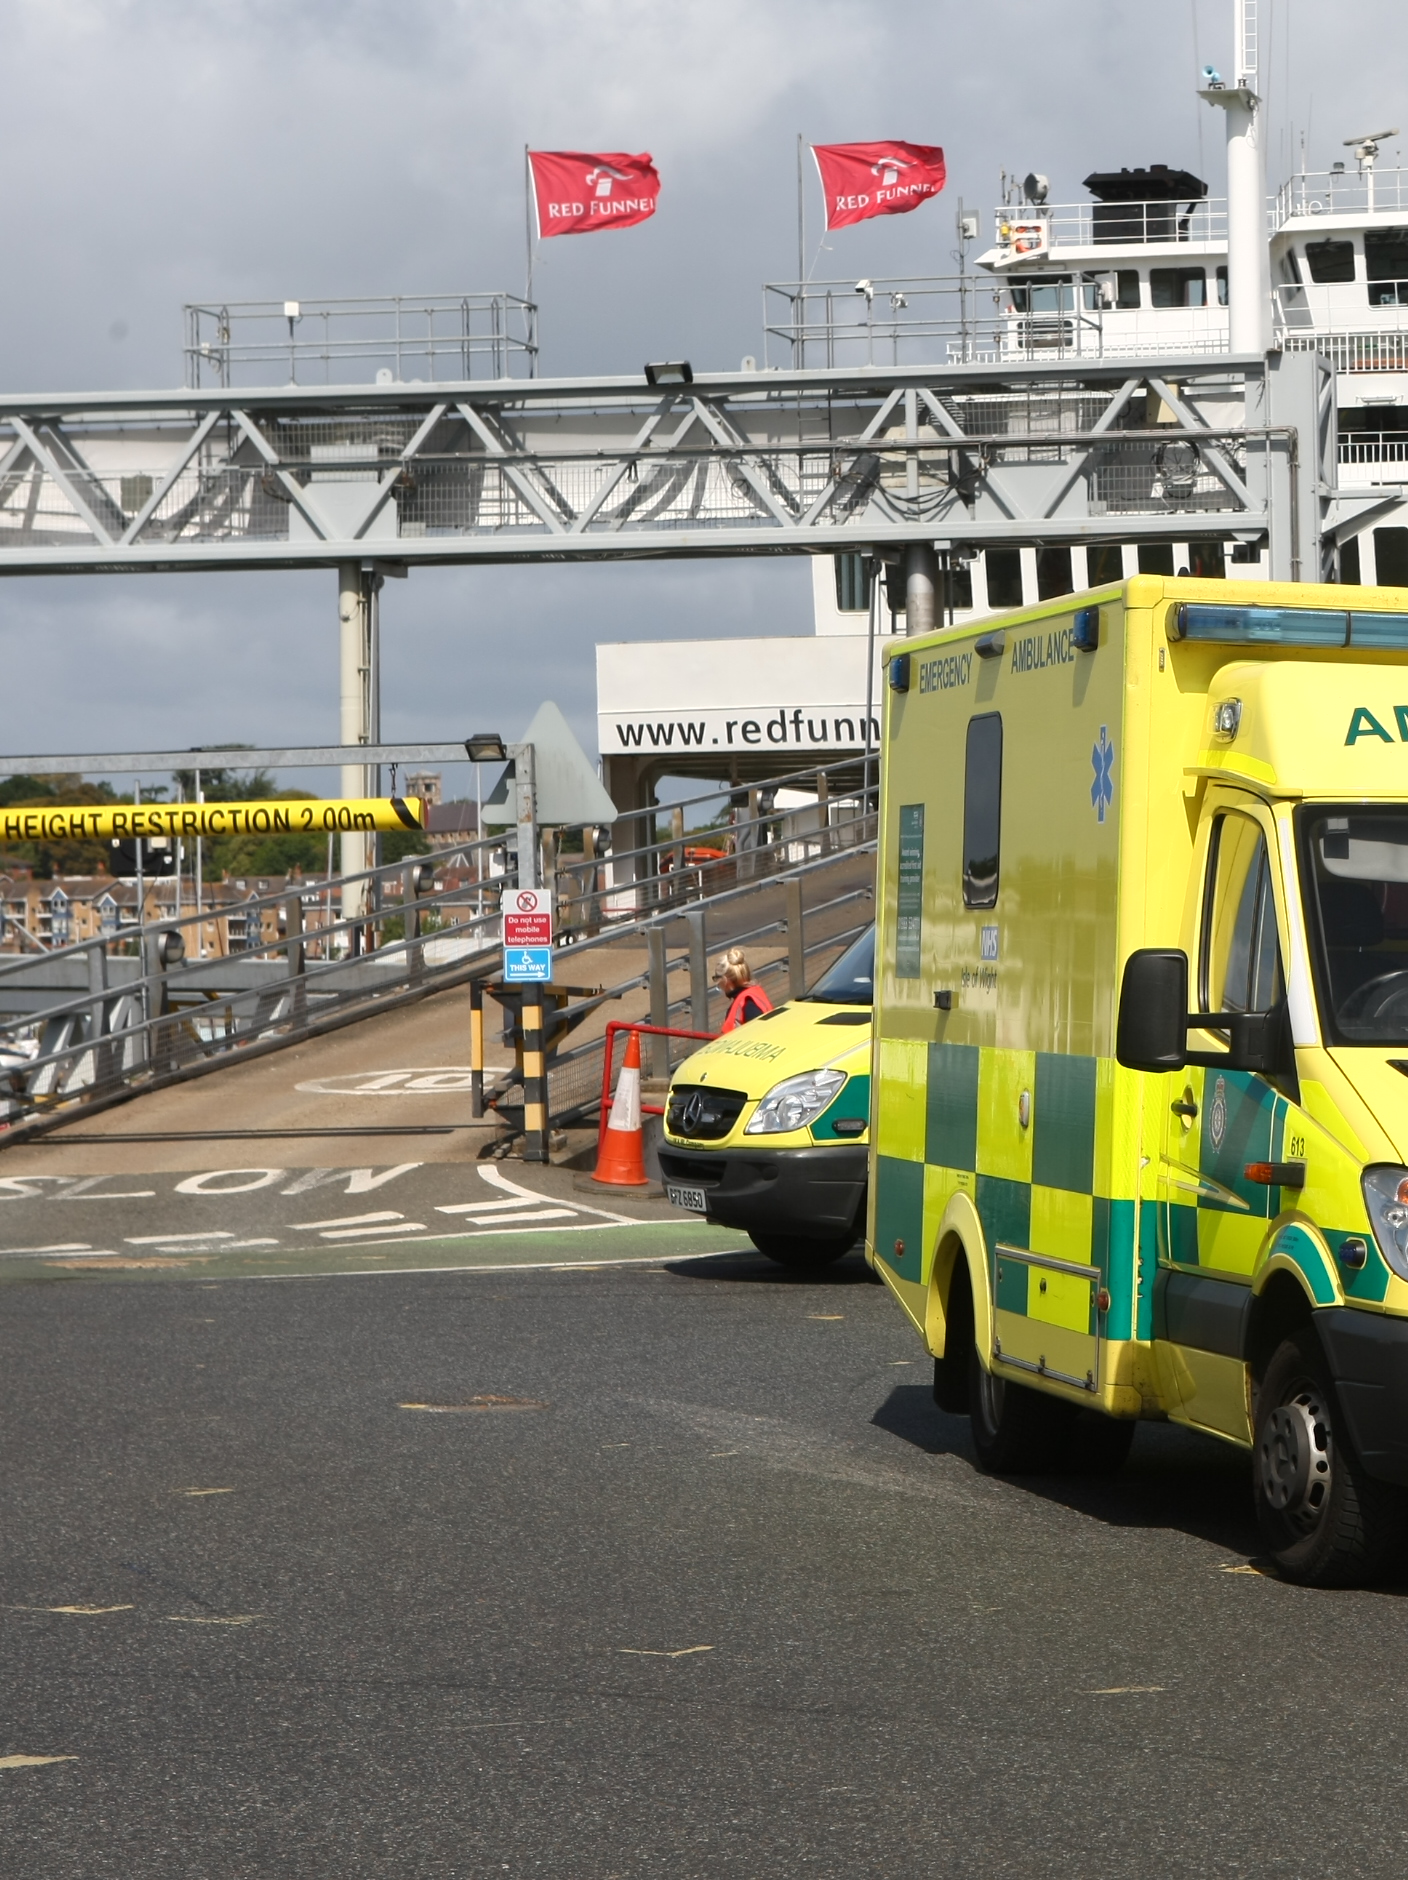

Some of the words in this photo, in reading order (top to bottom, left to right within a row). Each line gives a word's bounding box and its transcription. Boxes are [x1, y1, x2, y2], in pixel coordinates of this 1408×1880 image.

[549, 203, 585, 218] RED
[836, 194, 870, 211] RED
[920, 652, 973, 694] EMERGENCY
[5, 812, 102, 841] HEIGHT
[112, 807, 292, 838] RESTRICTION
[301, 806, 377, 832] 2.00m
[508, 936, 548, 944] telephones
[981, 929, 998, 957] NHS
[961, 966, 970, 988] Isle
[972, 966, 979, 988] of
[980, 967, 997, 994] Wight
[354, 1074, 496, 1090] 10
[1290, 1136, 1305, 1157] 613
[0, 1162, 424, 1200] SLOW
